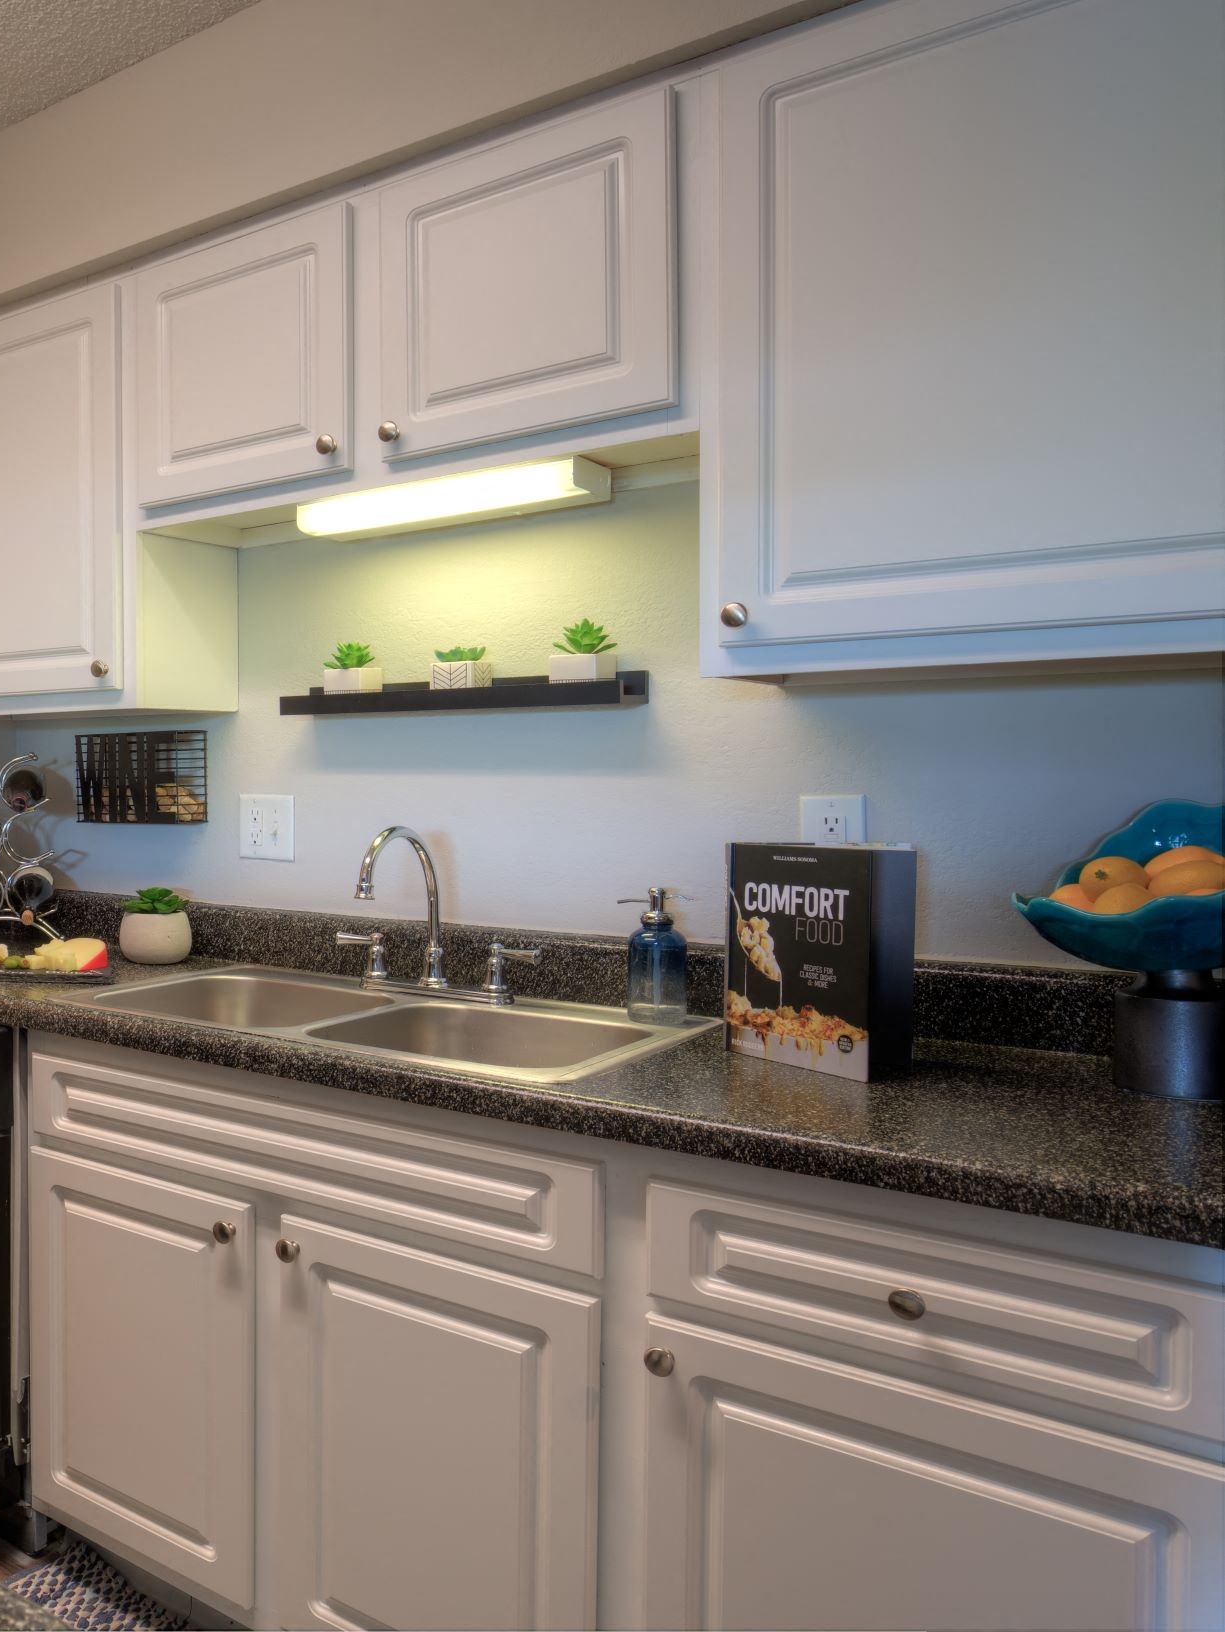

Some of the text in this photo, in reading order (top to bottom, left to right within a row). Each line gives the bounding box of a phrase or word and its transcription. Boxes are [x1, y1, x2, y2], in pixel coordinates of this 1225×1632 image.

[75, 731, 176, 824] WINE
[744, 881, 850, 921] COMFORT
[795, 917, 844, 946] FOOD
[814, 980, 829, 989] MORE
[823, 966, 834, 976] FOR
